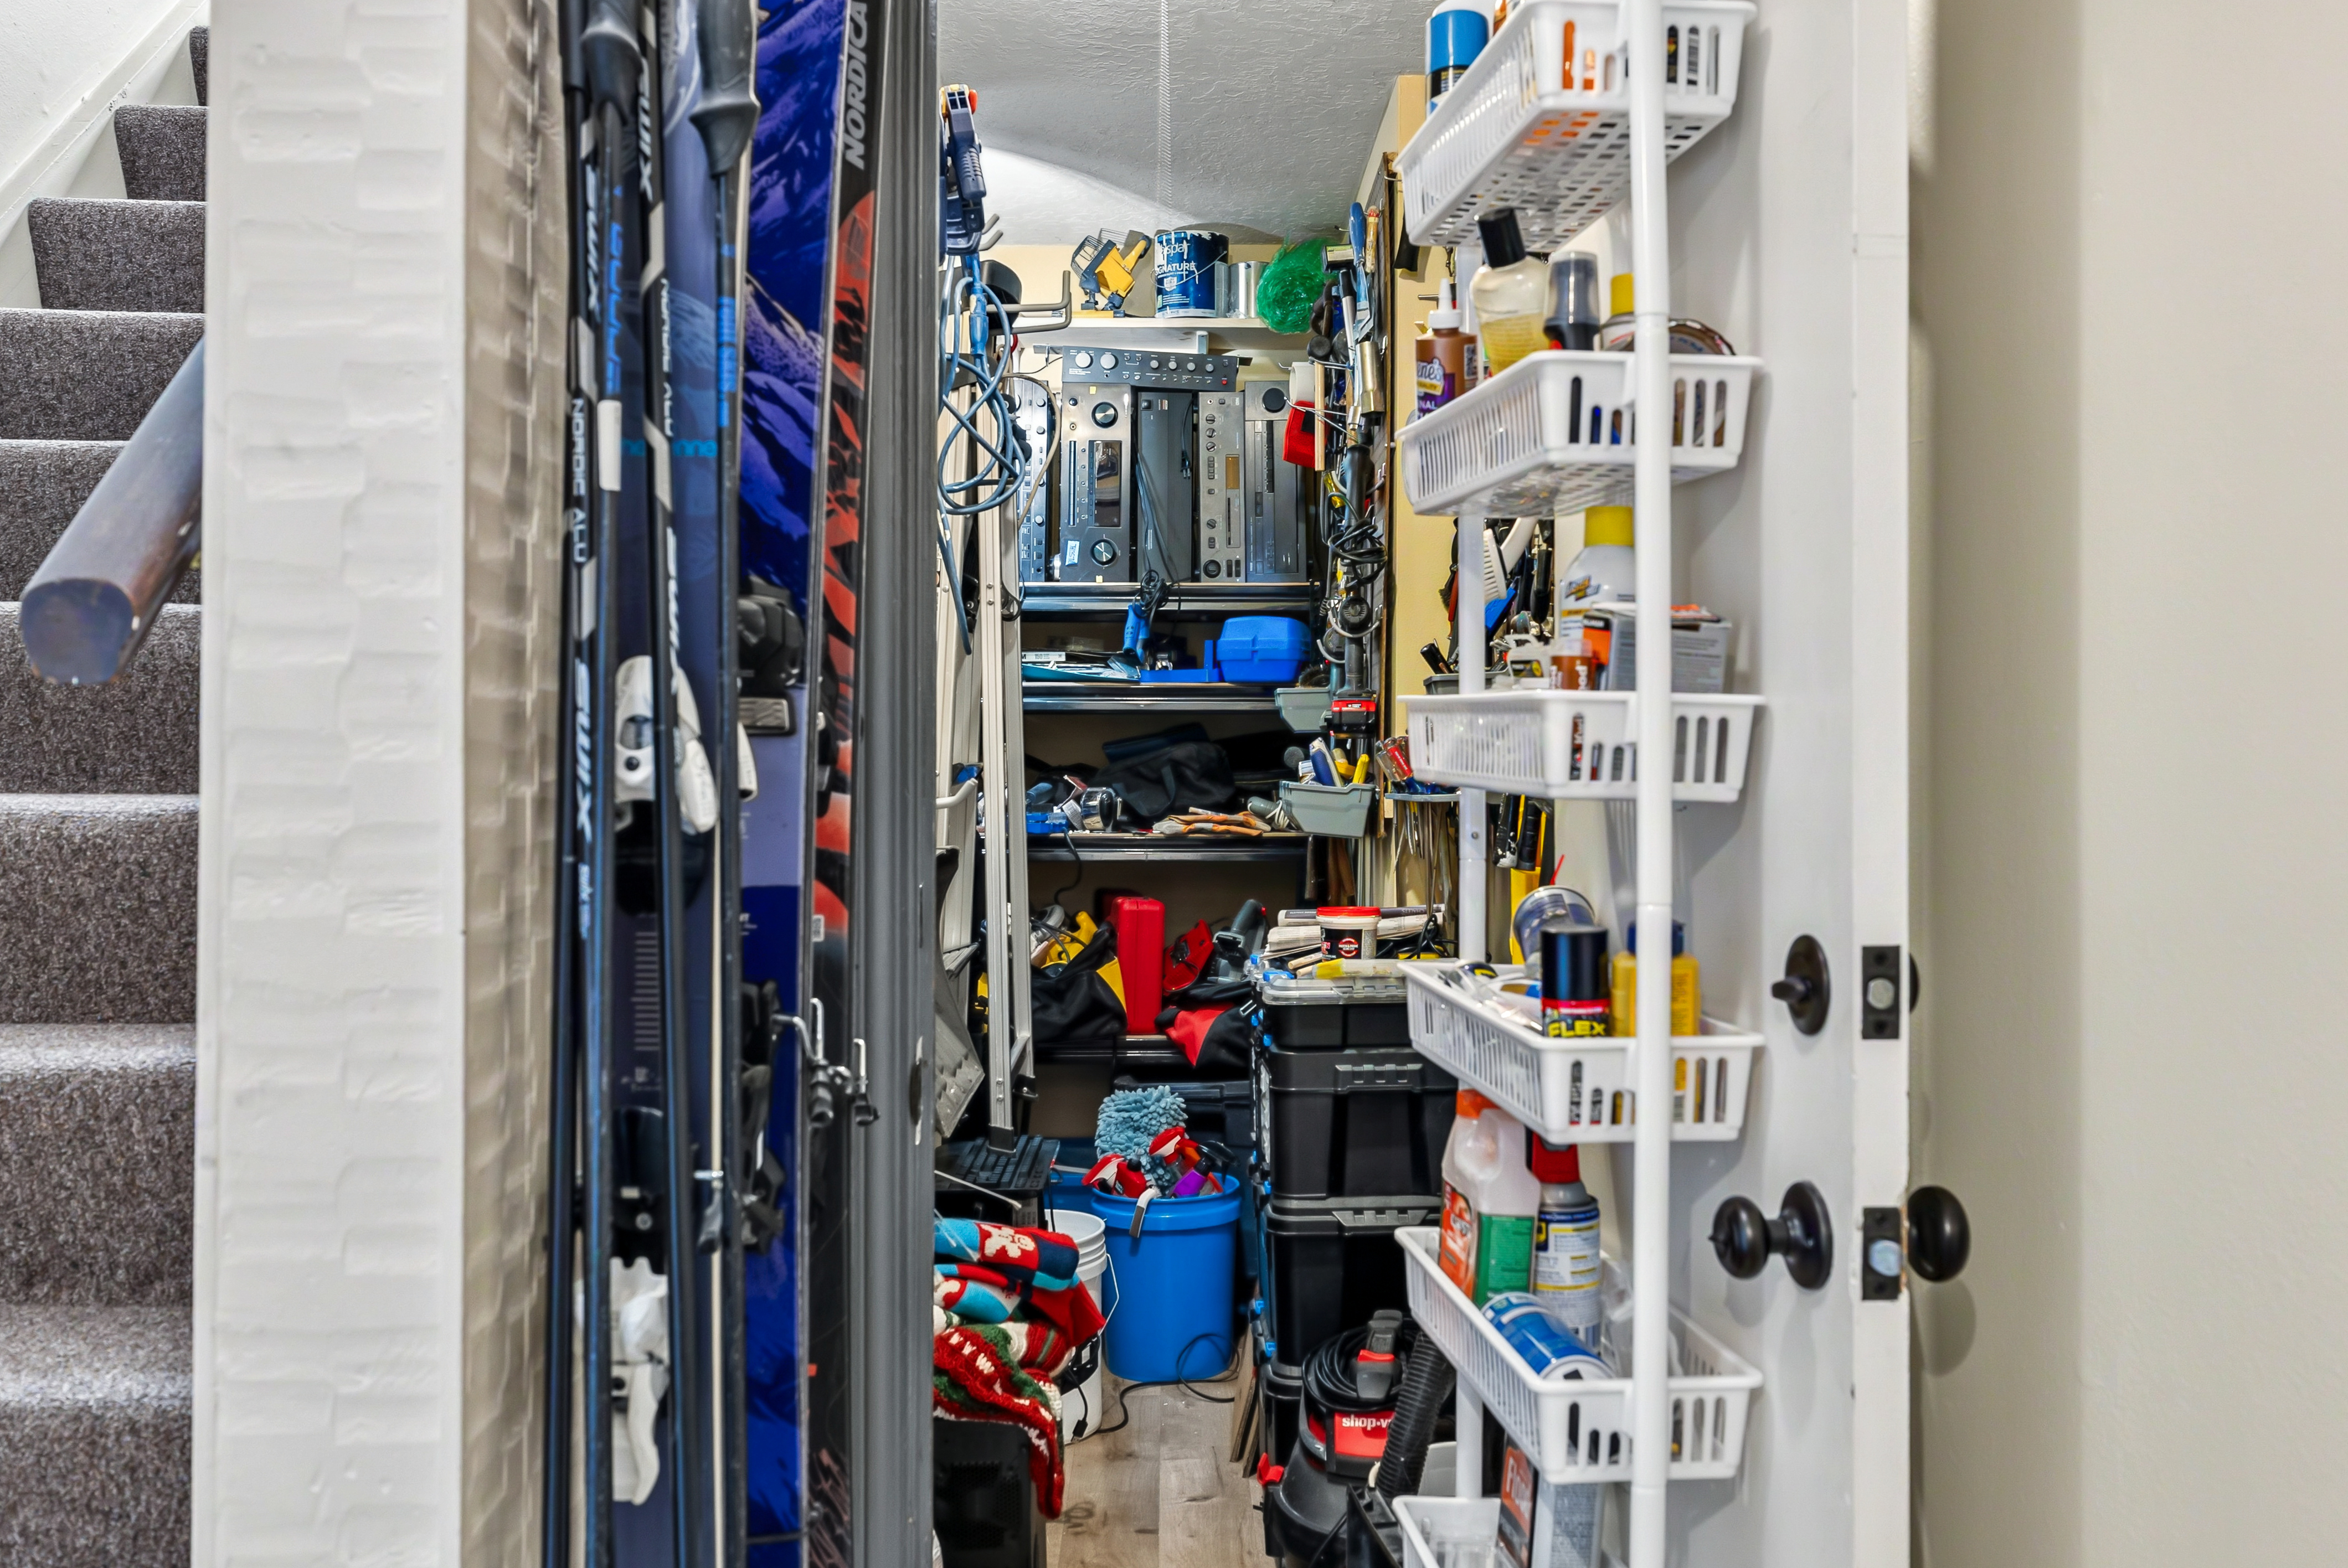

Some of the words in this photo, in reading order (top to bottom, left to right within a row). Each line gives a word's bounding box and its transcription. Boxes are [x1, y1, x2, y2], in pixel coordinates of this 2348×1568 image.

[843, 1, 867, 171] NORDICA
[571, 397, 585, 497] NORDIC
[573, 507, 587, 563] ALU
[574, 658, 592, 843] SWIX
[1548, 1020, 1606, 1038] FLEX
